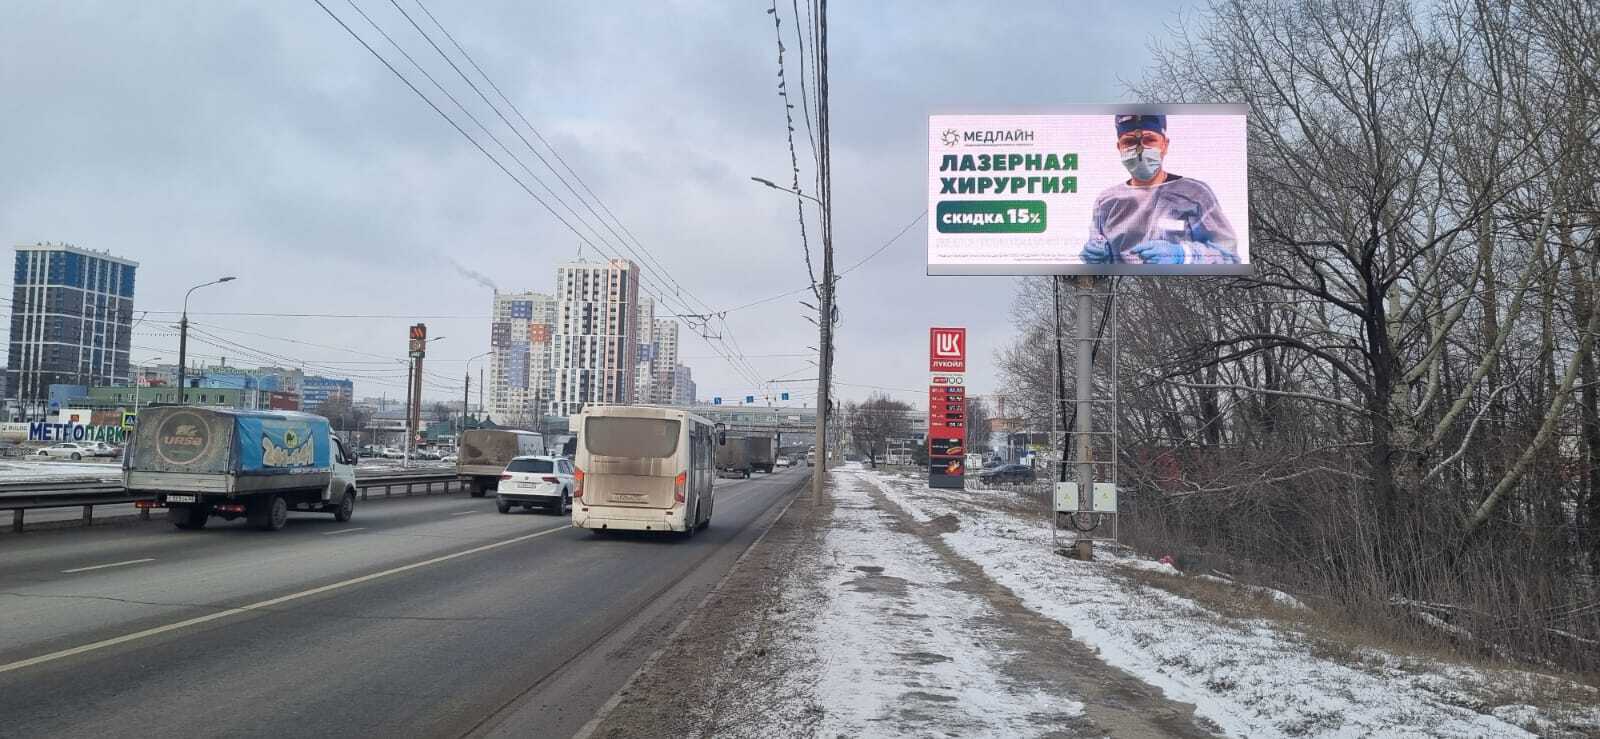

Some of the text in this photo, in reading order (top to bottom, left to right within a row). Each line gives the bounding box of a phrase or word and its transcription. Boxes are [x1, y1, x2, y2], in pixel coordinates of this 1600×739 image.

[963, 128, 1035, 143] МЕДЛАЙН
[939, 153, 1079, 172] ЛАЗЕРНАЯ
[939, 176, 1079, 194] ХИРУРГИЯ
[942, 208, 1041, 226] СКИДКА 15%
[29, 423, 125, 442] МЕТРОПАРК
